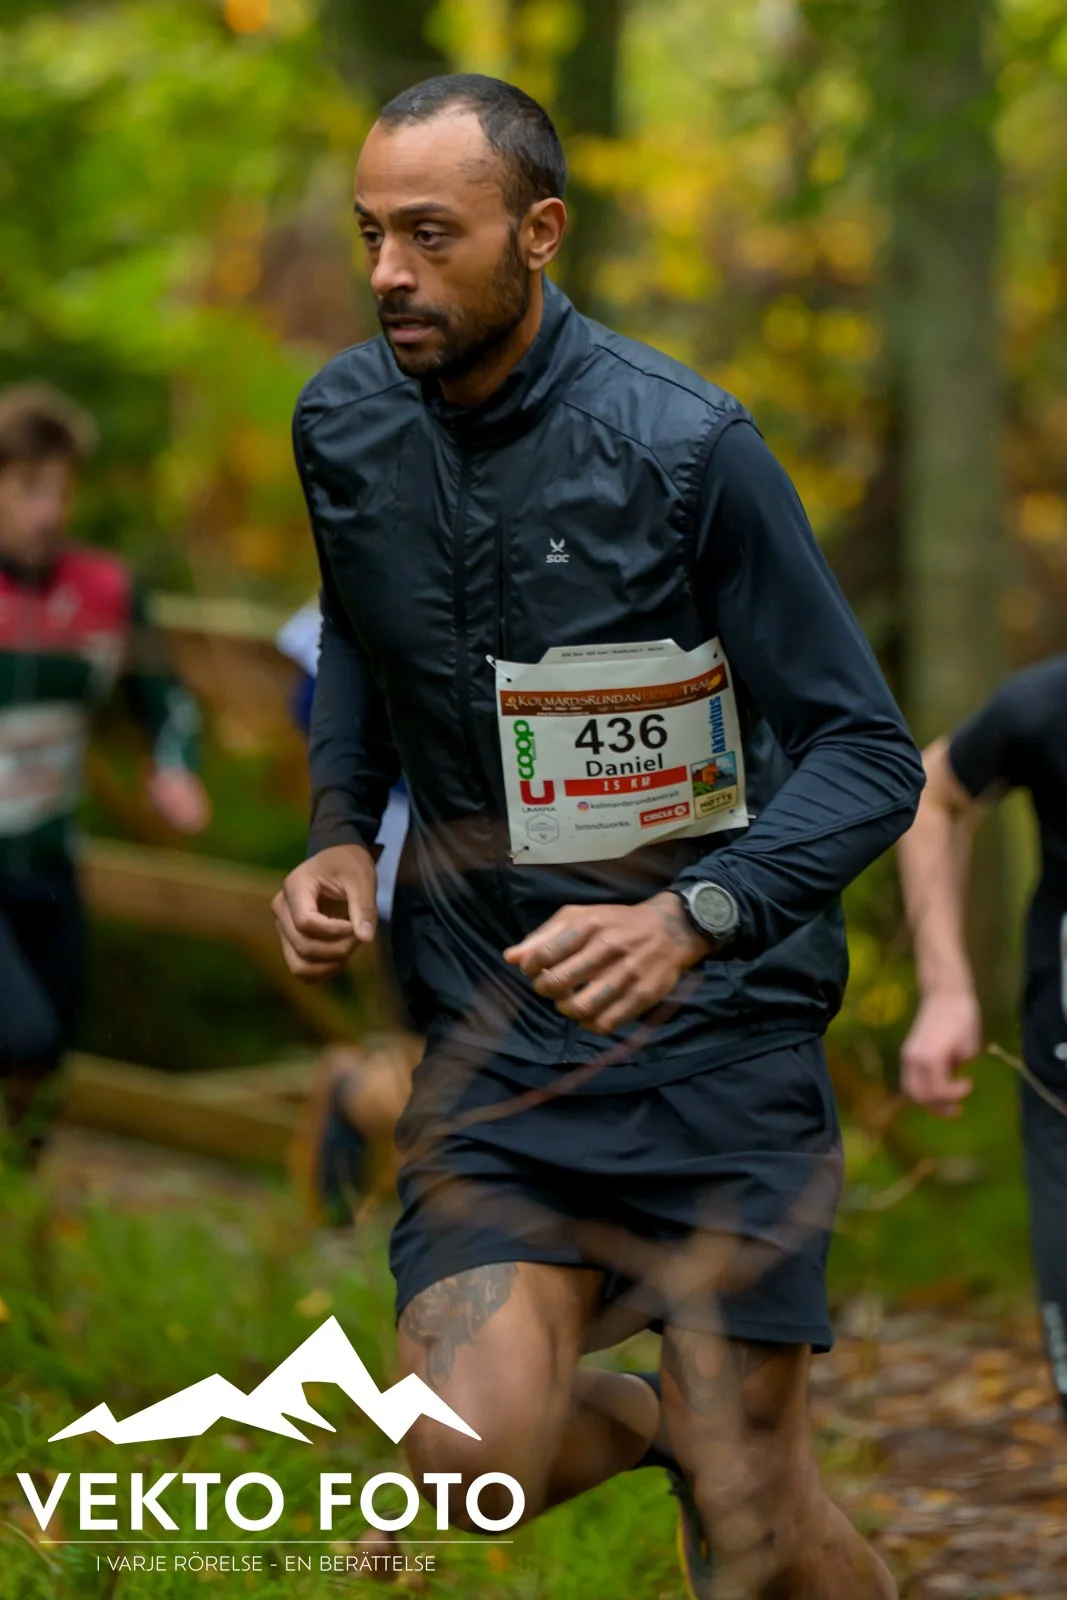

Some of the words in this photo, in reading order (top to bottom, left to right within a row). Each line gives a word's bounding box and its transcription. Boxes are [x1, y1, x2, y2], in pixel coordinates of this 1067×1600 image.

[513, 719, 534, 780] coop
[574, 714, 668, 755] 436
[586, 753, 663, 777] Daniel
[603, 780, 620, 791] 15
[631, 777, 651, 789] KM
